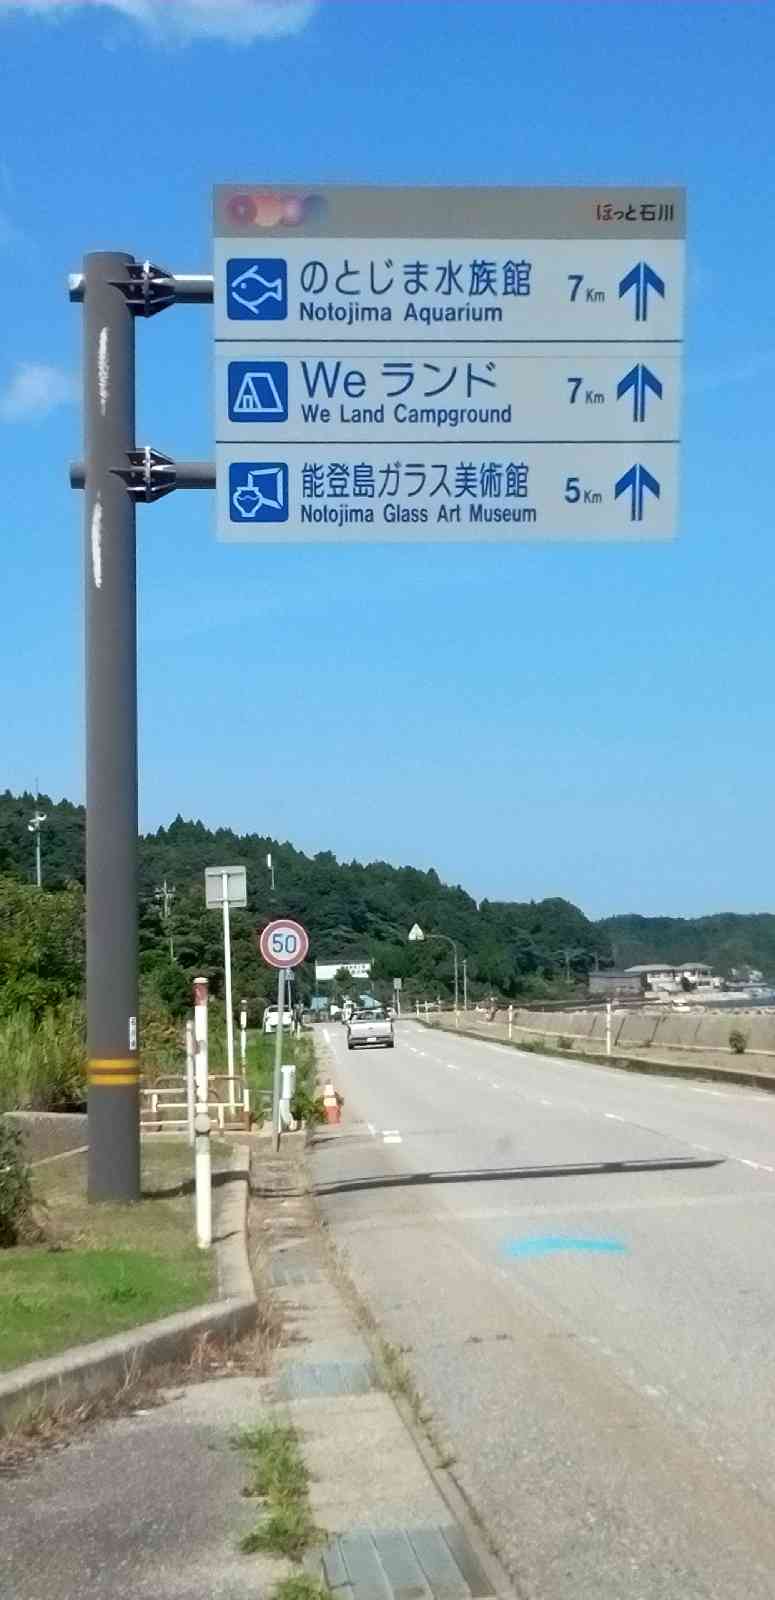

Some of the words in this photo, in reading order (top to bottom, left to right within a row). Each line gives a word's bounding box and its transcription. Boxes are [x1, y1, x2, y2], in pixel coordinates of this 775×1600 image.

[596, 203, 674, 221] ほっと石川
[300, 260, 532, 297] のとじま水族館
[567, 275, 584, 302] 7
[586, 288, 605, 303] Km
[300, 302, 392, 324] Notojima
[404, 303, 503, 323] Aquarium
[302, 361, 366, 398] We
[382, 362, 497, 398] ランド
[567, 377, 583, 404] 7
[586, 391, 604, 404] Km
[302, 404, 330, 424] We
[340, 404, 384, 424] Land
[394, 404, 511, 426] Campground
[301, 463, 529, 498] 能登島ガラス美術館
[564, 478, 580, 504] 5
[583, 490, 602, 504] Km
[301, 504, 373, 526] Notojima
[383, 505, 428, 523] Glass
[437, 505, 462, 523] Art
[470, 505, 536, 523] Museum
[272, 933, 297, 953] 50
